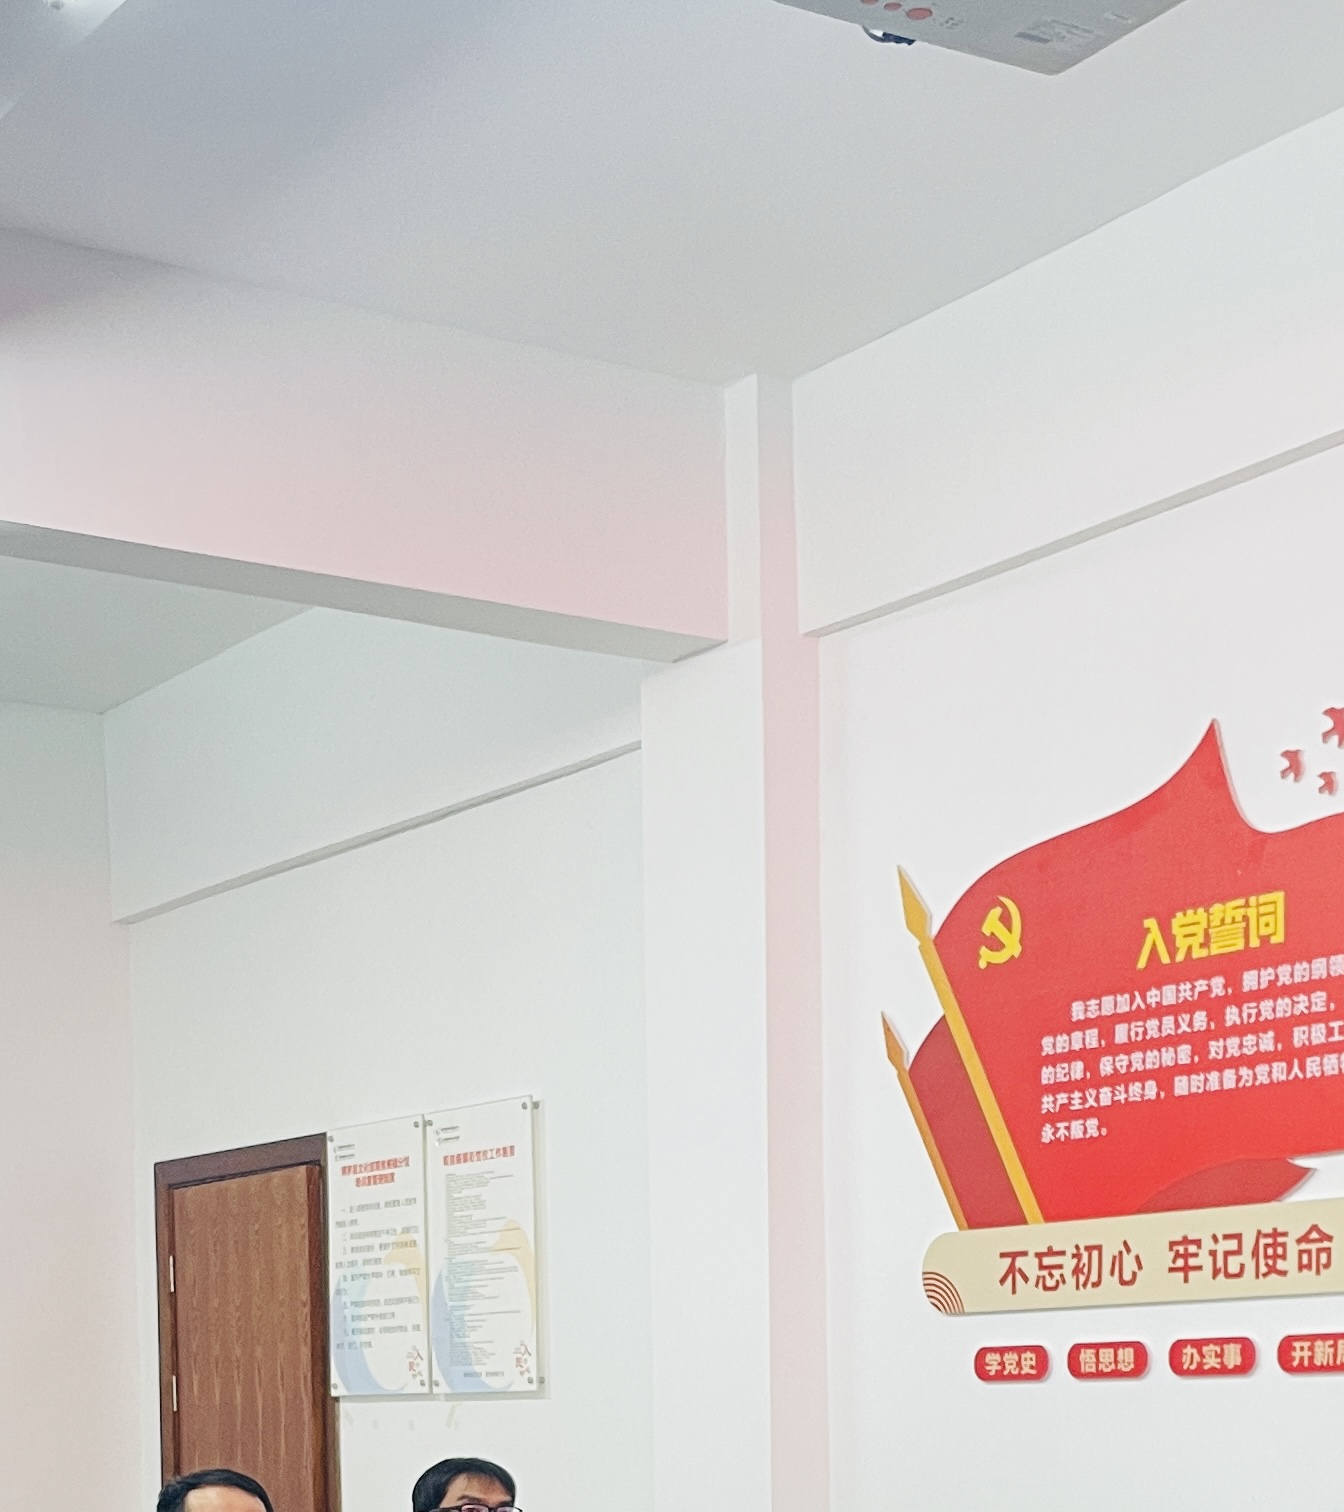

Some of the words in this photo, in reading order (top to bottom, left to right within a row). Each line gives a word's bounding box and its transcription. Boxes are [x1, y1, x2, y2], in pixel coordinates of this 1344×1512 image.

[1136, 890, 1285, 970] 入党誓词
[999, 1238, 1144, 1296] 不忘初心
[1167, 1223, 1335, 1285] 牢记使命
[984, 1351, 1038, 1377] 学党史
[1079, 1347, 1136, 1374] 悟思想
[1181, 1342, 1243, 1371] 办实事
